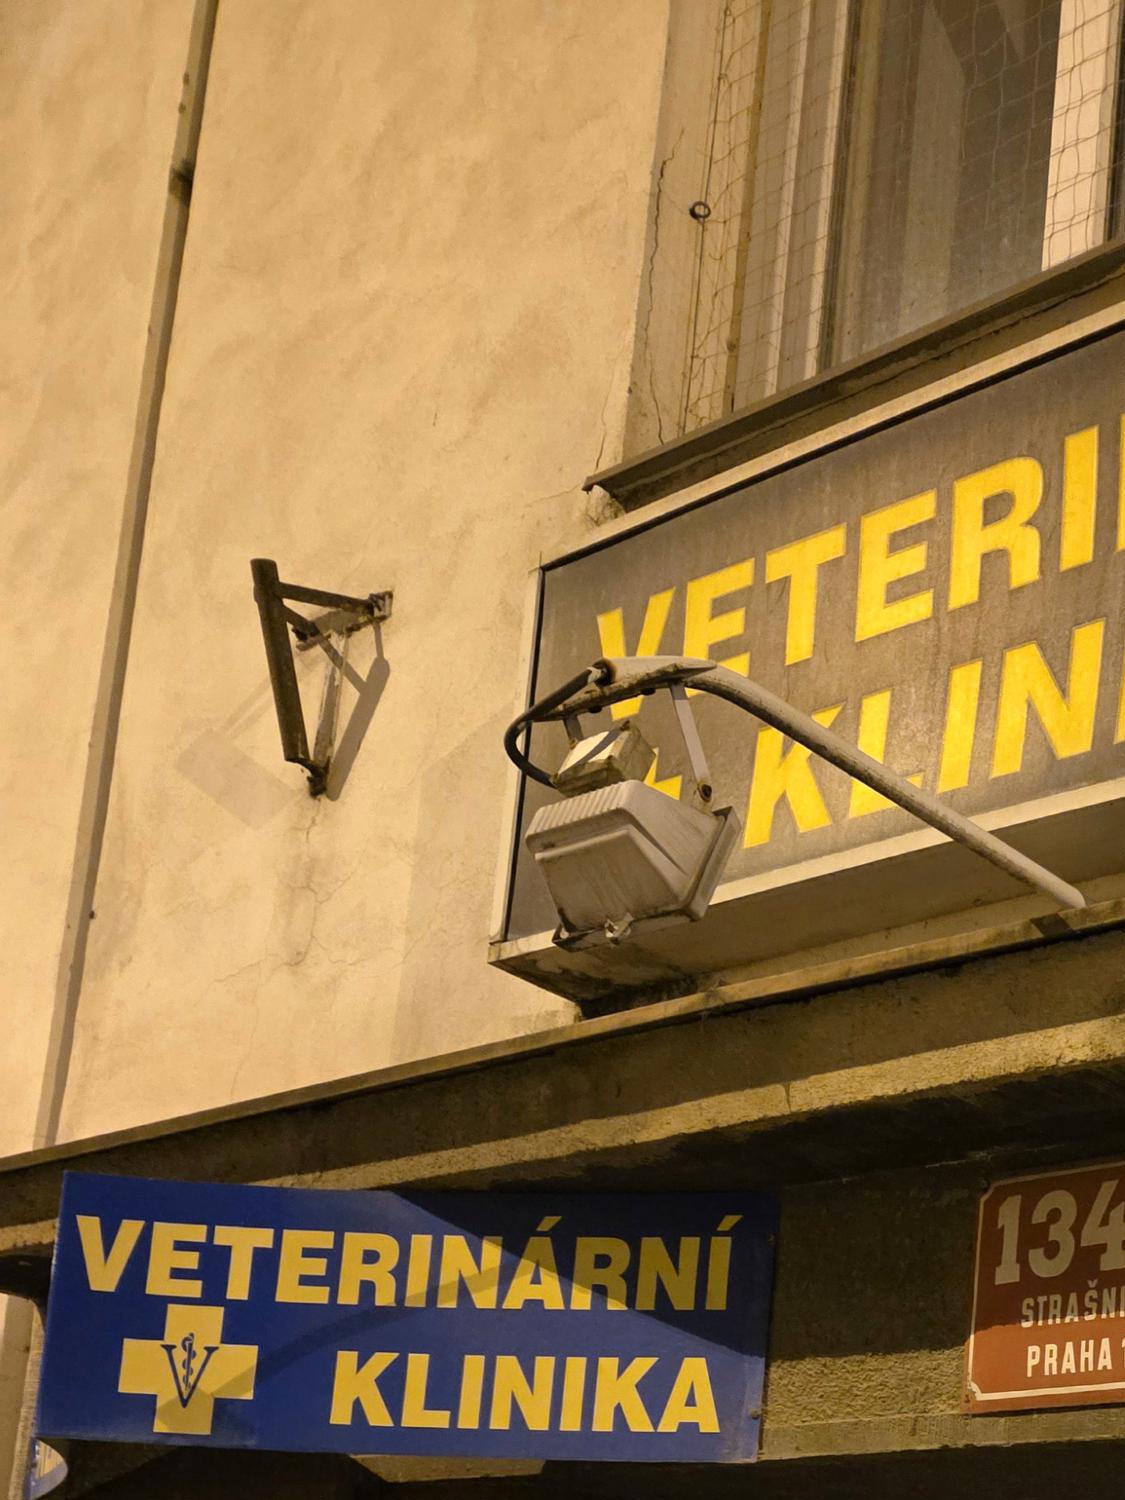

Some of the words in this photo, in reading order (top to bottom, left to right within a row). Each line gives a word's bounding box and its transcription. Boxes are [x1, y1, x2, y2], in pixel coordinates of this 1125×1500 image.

[76, 1215, 743, 1310] VETERINÁRNÍ
[329, 1350, 720, 1433] KLINIKA
[1027, 1337, 1112, 1377] PRAHA
